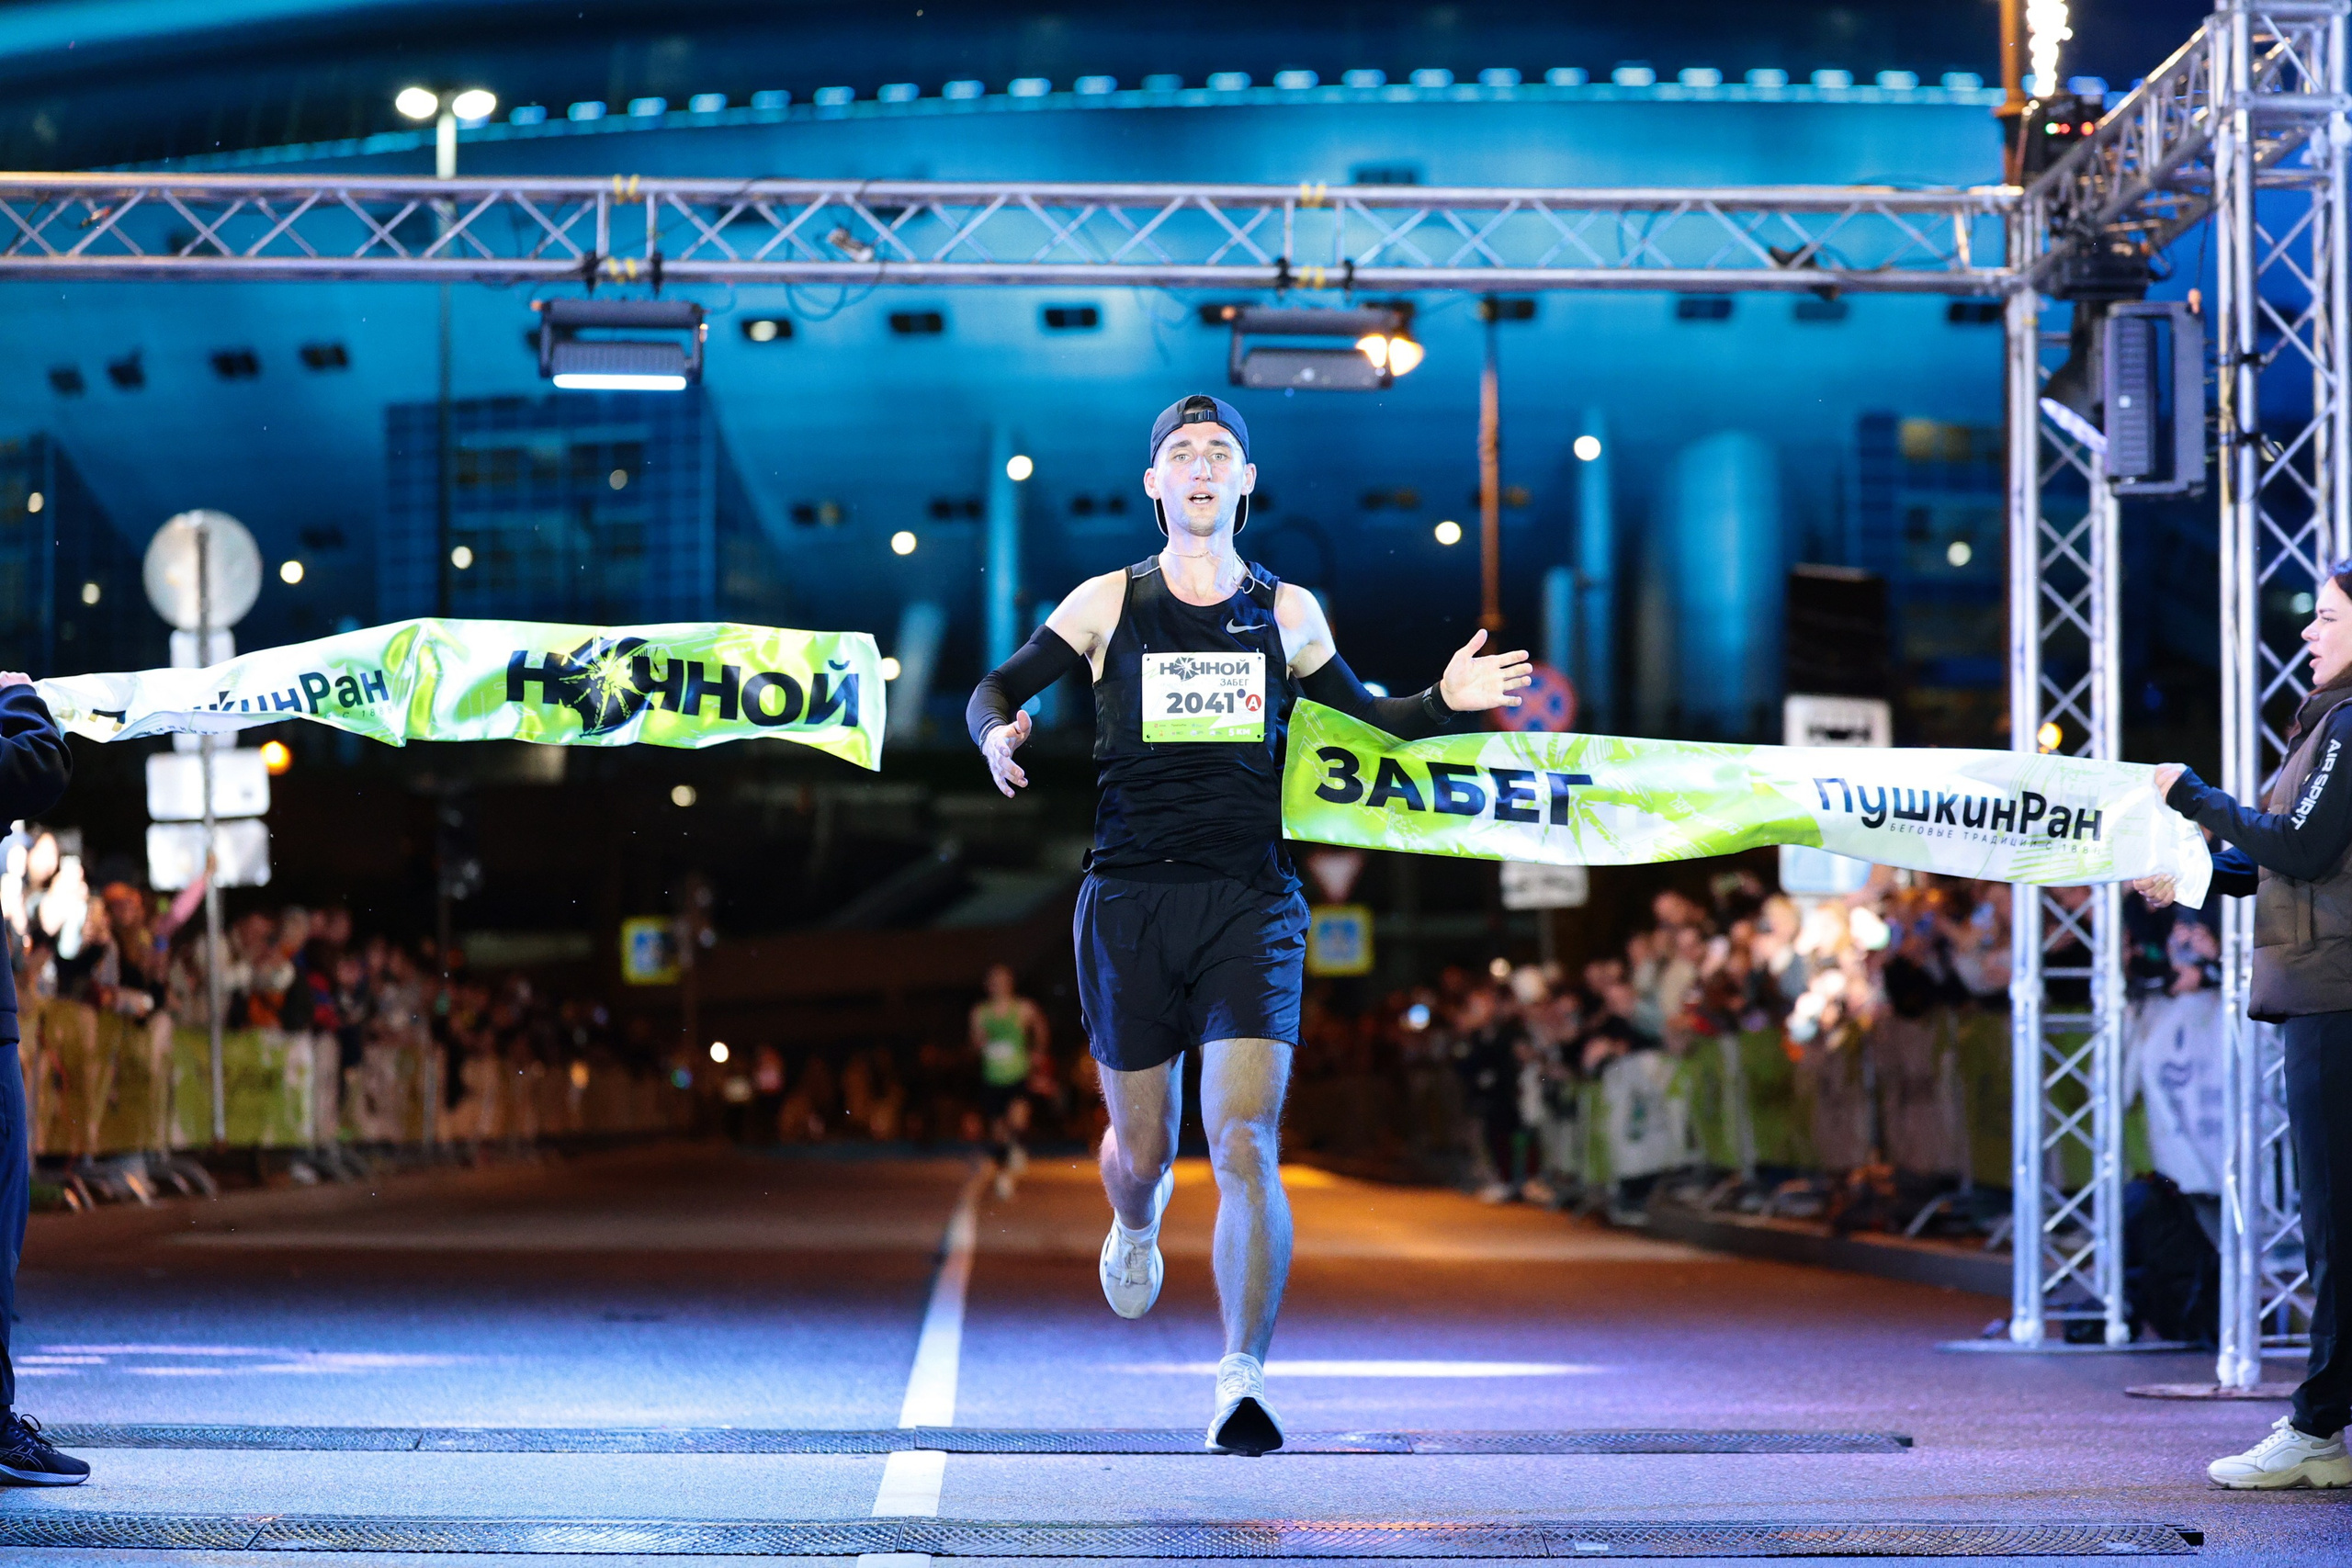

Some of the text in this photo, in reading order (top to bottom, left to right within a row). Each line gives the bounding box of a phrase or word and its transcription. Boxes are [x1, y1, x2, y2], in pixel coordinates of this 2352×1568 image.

[1219, 678, 1250, 687] ЗАБЕГ
[1166, 692, 1234, 714] 2041
[1314, 746, 1593, 826] ЗАБЕГ
[1813, 777, 2103, 841] ПушкинРан
[1890, 823, 1953, 839] БЕГОВЫЕ
[1963, 831, 2038, 848] ТРАДИЦИИ
